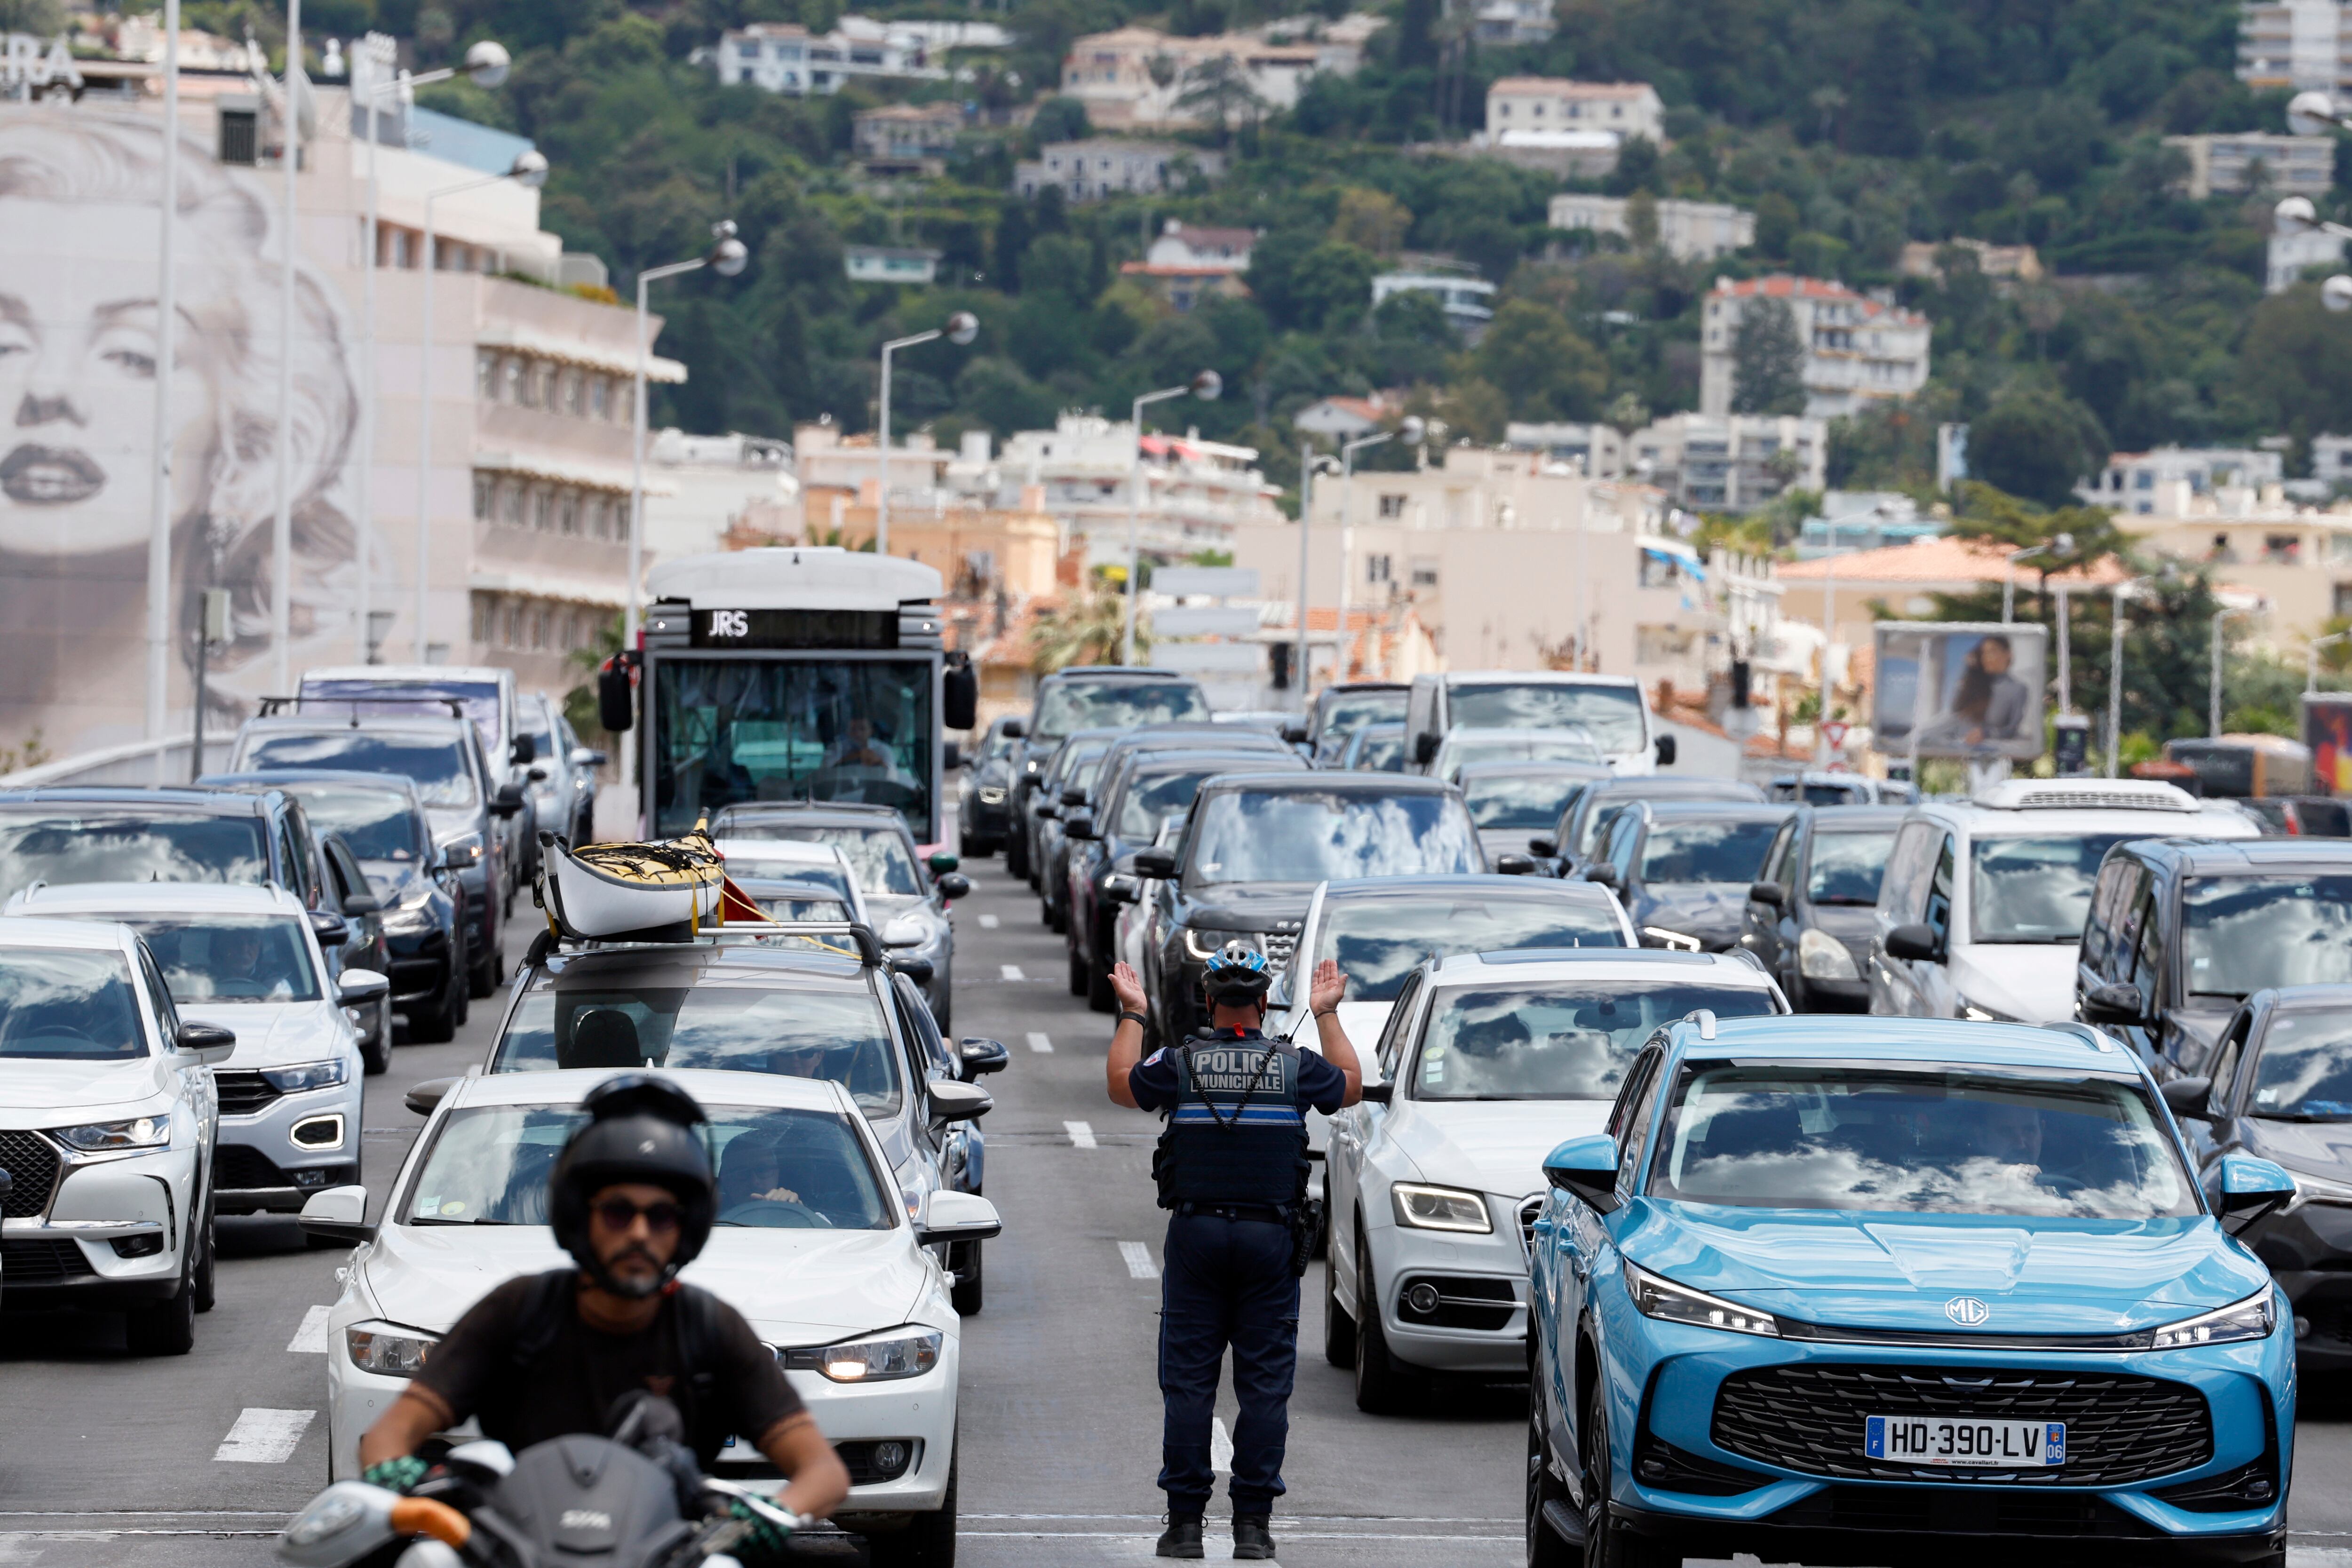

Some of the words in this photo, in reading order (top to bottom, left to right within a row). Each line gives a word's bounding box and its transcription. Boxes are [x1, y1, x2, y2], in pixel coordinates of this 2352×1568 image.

[0, 33, 85, 88] RA
[1196, 1051, 1279, 1075] POLICE
[1950, 1299, 1984, 1322] MG
[1873, 1440, 1879, 1449] F
[1892, 1423, 2039, 1457] HD-390-LV
[2047, 1444, 2063, 1459] 06
